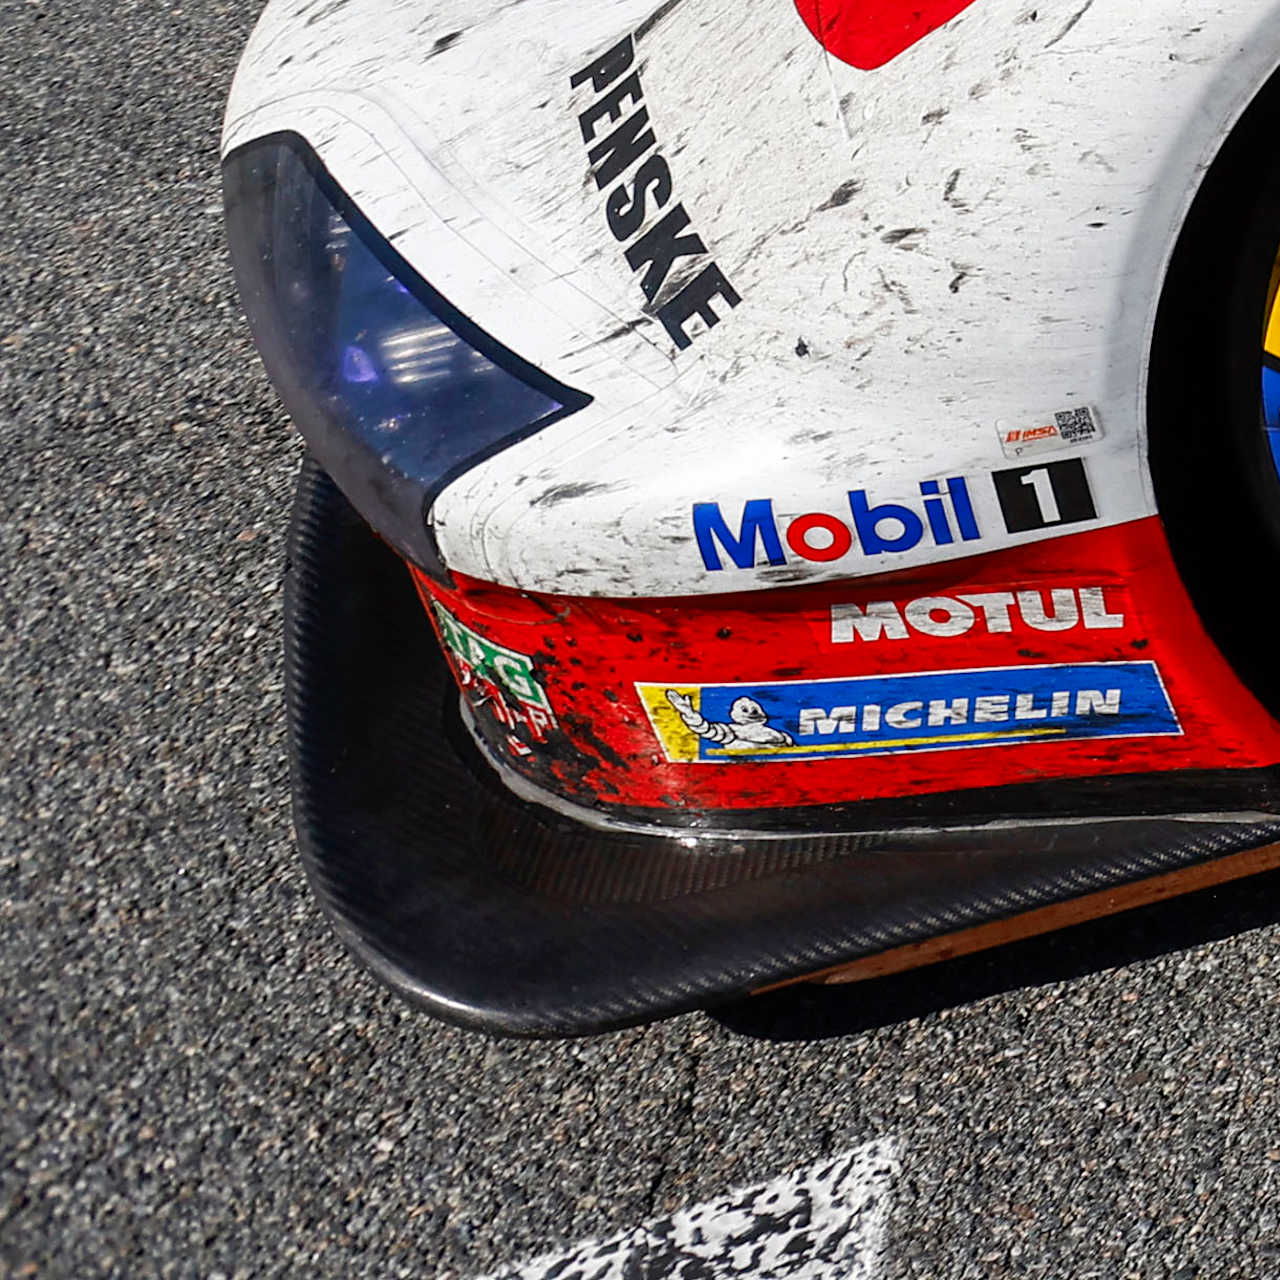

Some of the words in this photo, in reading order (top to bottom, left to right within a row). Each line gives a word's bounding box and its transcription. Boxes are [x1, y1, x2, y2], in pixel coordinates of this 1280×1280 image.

[570, 32, 743, 351] PENSKE
[1022, 425, 1058, 442] IMSA
[692, 476, 982, 572] Mobil
[1019, 467, 1061, 524] 1
[830, 586, 1124, 644] MOTUL
[797, 687, 1121, 737] MICHELIN
